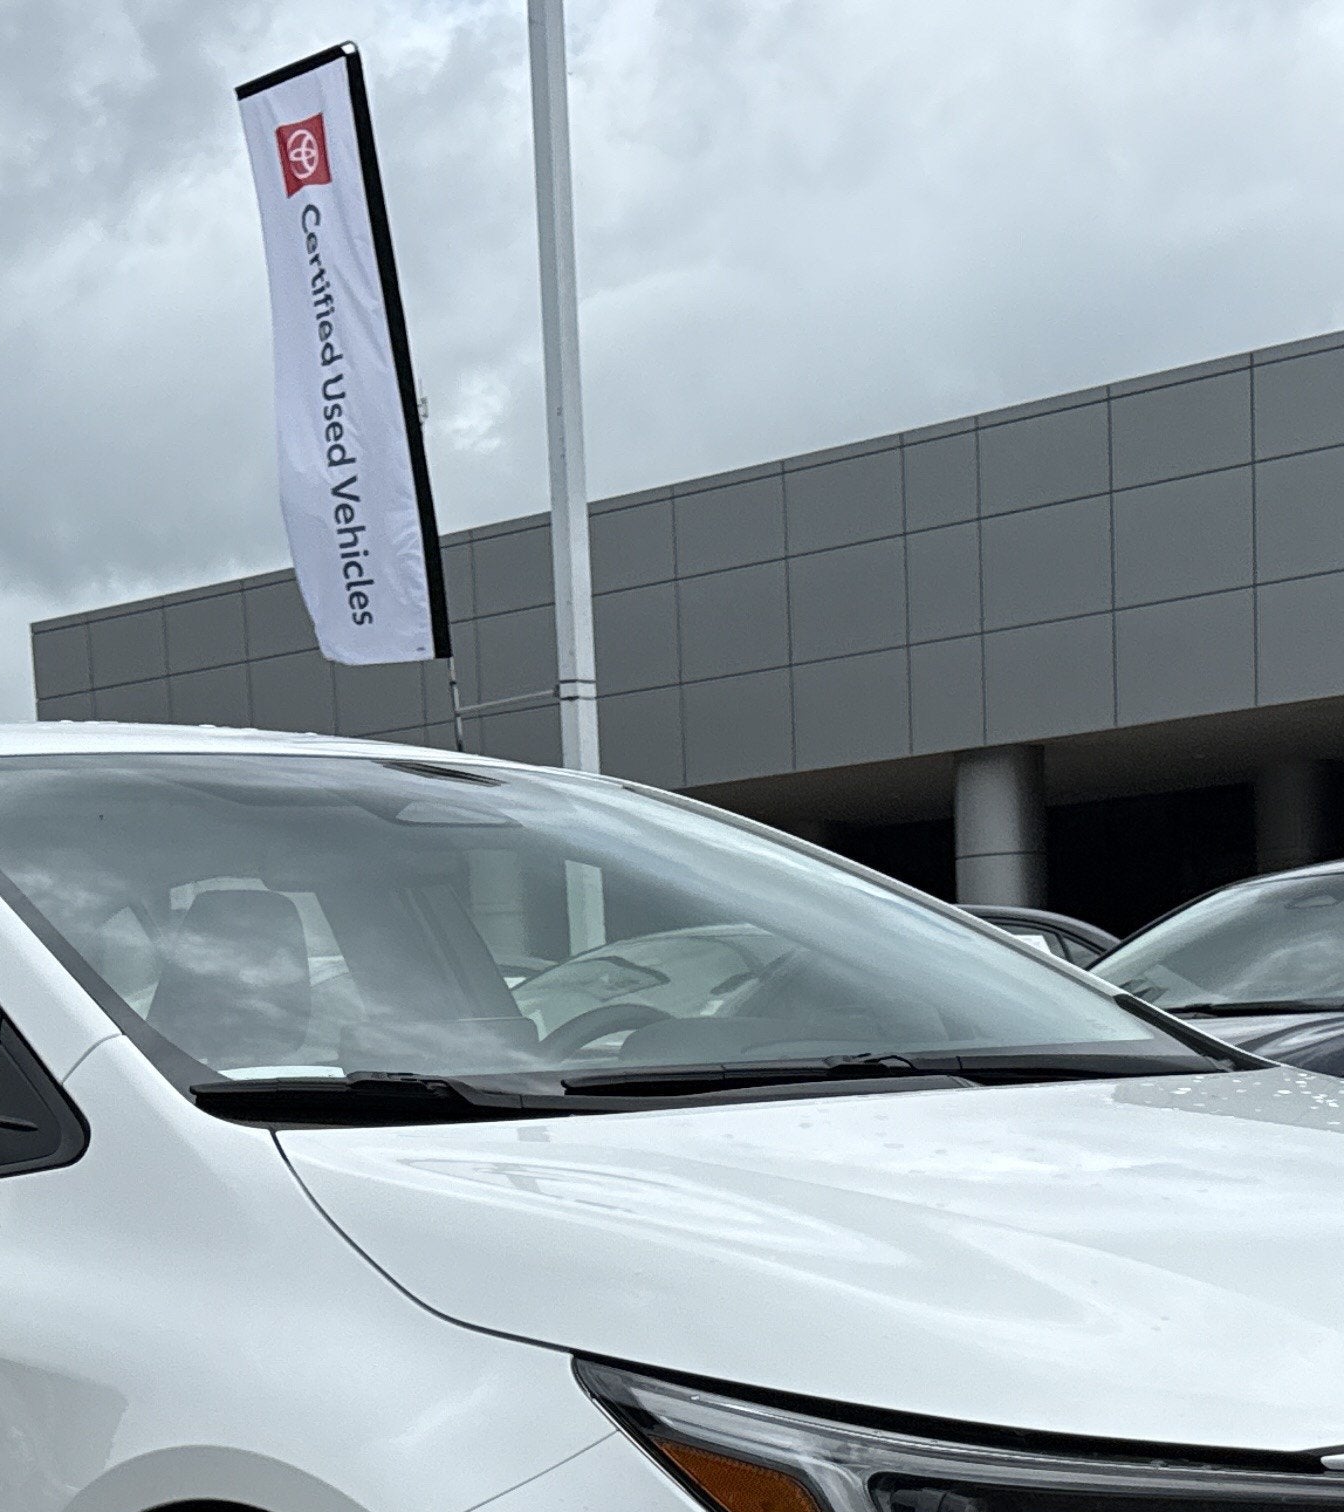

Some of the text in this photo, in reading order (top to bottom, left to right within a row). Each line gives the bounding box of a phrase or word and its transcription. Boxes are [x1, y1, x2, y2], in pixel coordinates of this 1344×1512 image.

[301, 204, 375, 626] Certified Used Vehicles
